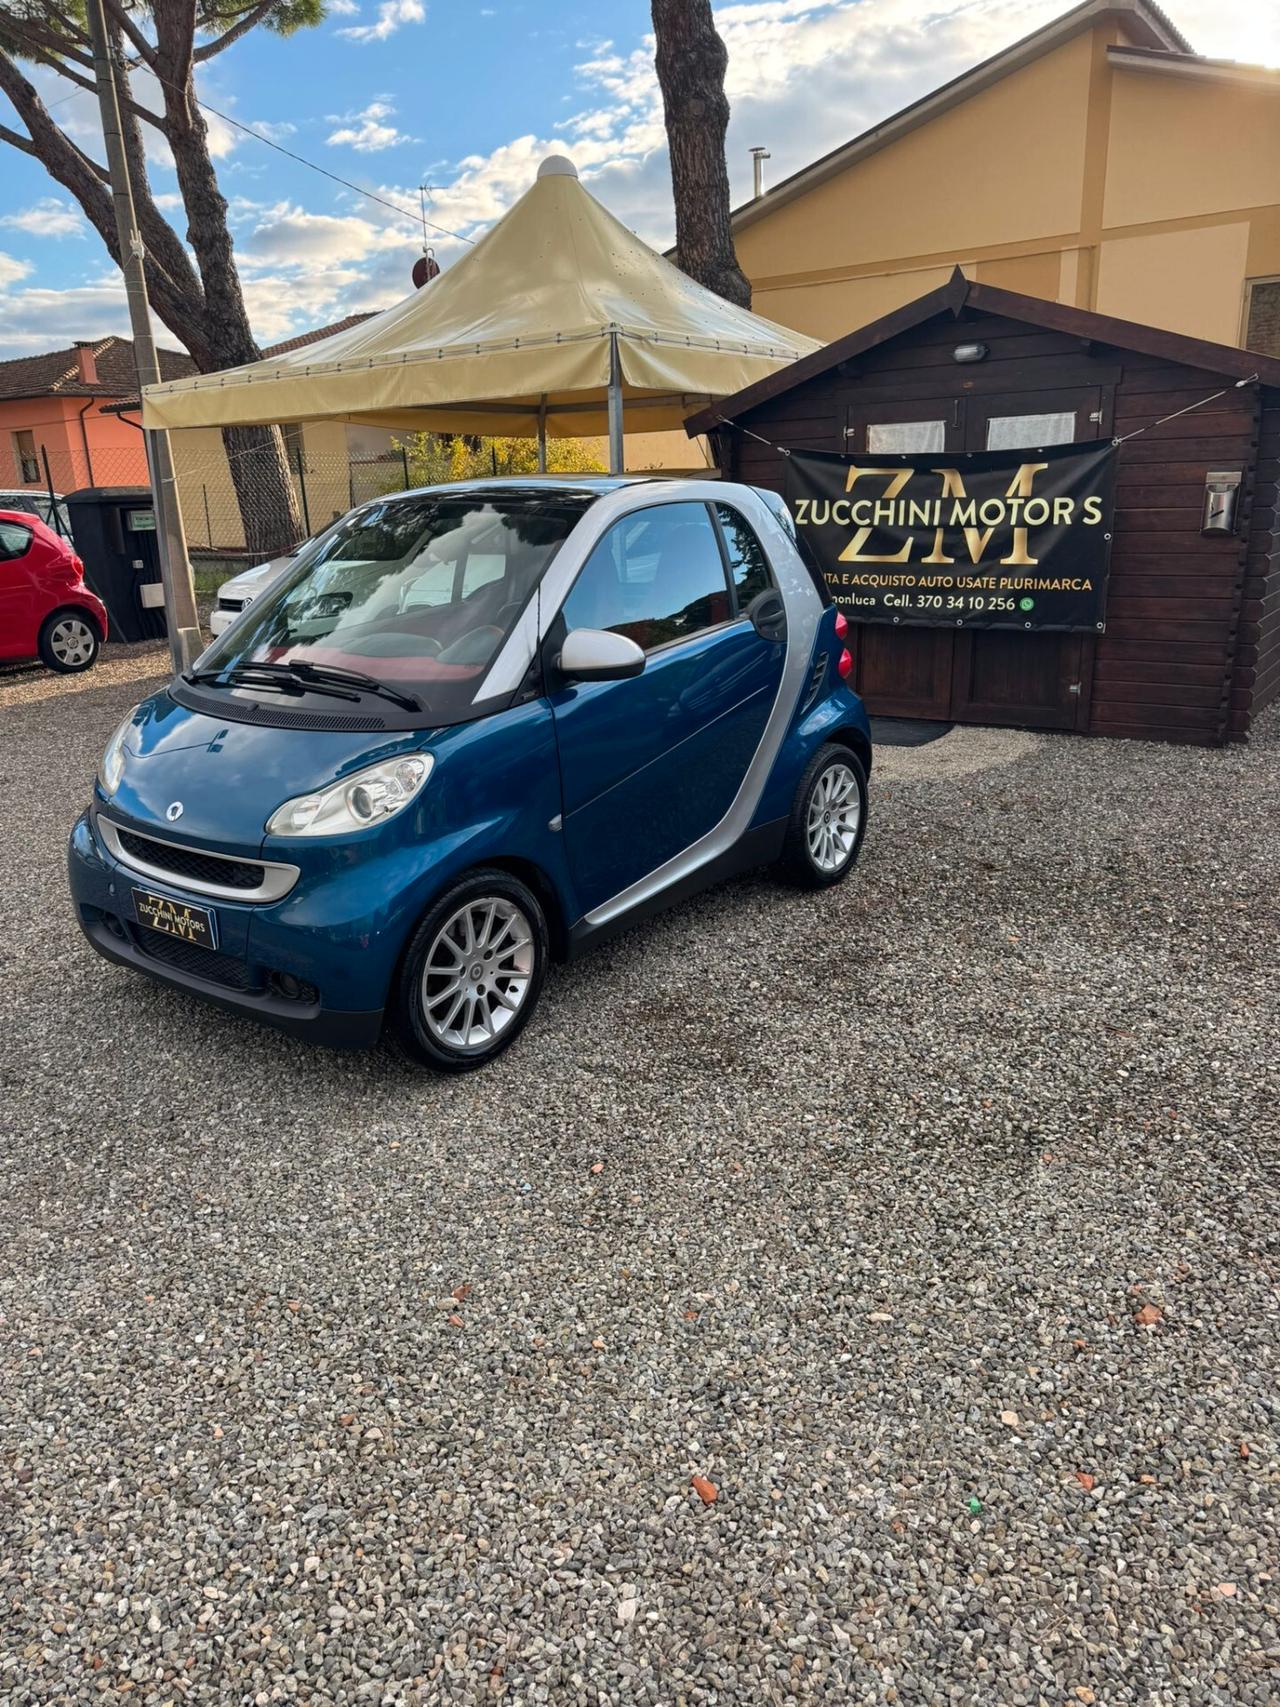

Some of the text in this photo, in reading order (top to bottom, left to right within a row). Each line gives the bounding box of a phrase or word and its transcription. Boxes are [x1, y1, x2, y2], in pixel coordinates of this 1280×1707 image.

[795, 499, 941, 527] ZUCCHINI
[842, 573, 850, 585] E
[851, 574, 917, 588] ACQUISTO
[918, 575, 954, 588] AUTO
[956, 576, 997, 589] USATE
[1000, 577, 1092, 591] PLURIMARCA
[883, 593, 913, 607] Cell.
[916, 594, 943, 608] 370
[946, 596, 964, 609] 34
[968, 597, 984, 610] 10
[987, 597, 1016, 611] 256
[139, 902, 205, 932] ZUCCHINI MOTORS
